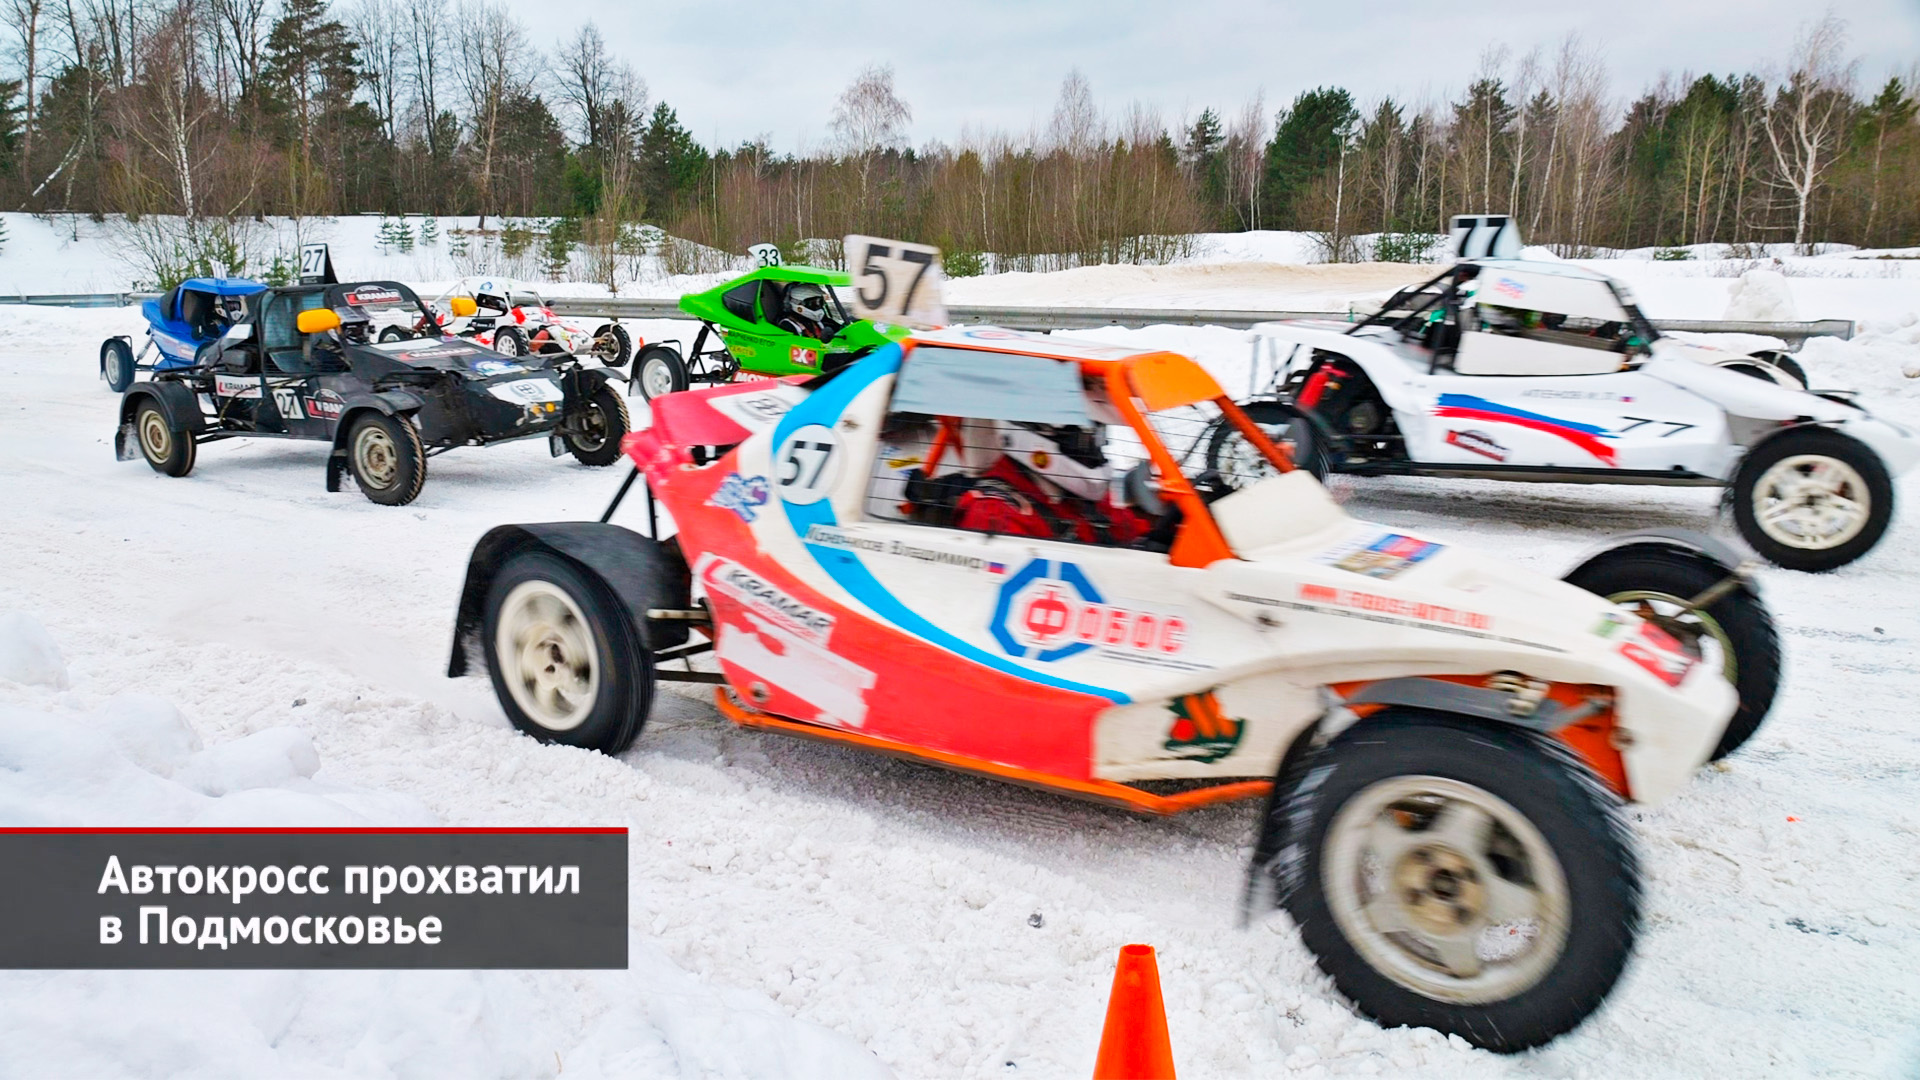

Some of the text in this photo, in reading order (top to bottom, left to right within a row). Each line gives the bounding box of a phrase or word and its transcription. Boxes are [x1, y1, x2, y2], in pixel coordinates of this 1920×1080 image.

[1458, 218, 1507, 257] 77
[302, 248, 323, 273] 27
[758, 249, 779, 267] 33
[859, 243, 933, 316] 57
[356, 290, 400, 301] KRAMAR
[759, 339, 775, 347] ЕГОР
[276, 390, 298, 416] 27
[1618, 416, 1696, 438] 77
[780, 440, 834, 489] 57
[725, 569, 832, 631] KRAMAR
[1023, 589, 1187, 655] ФОБОС
